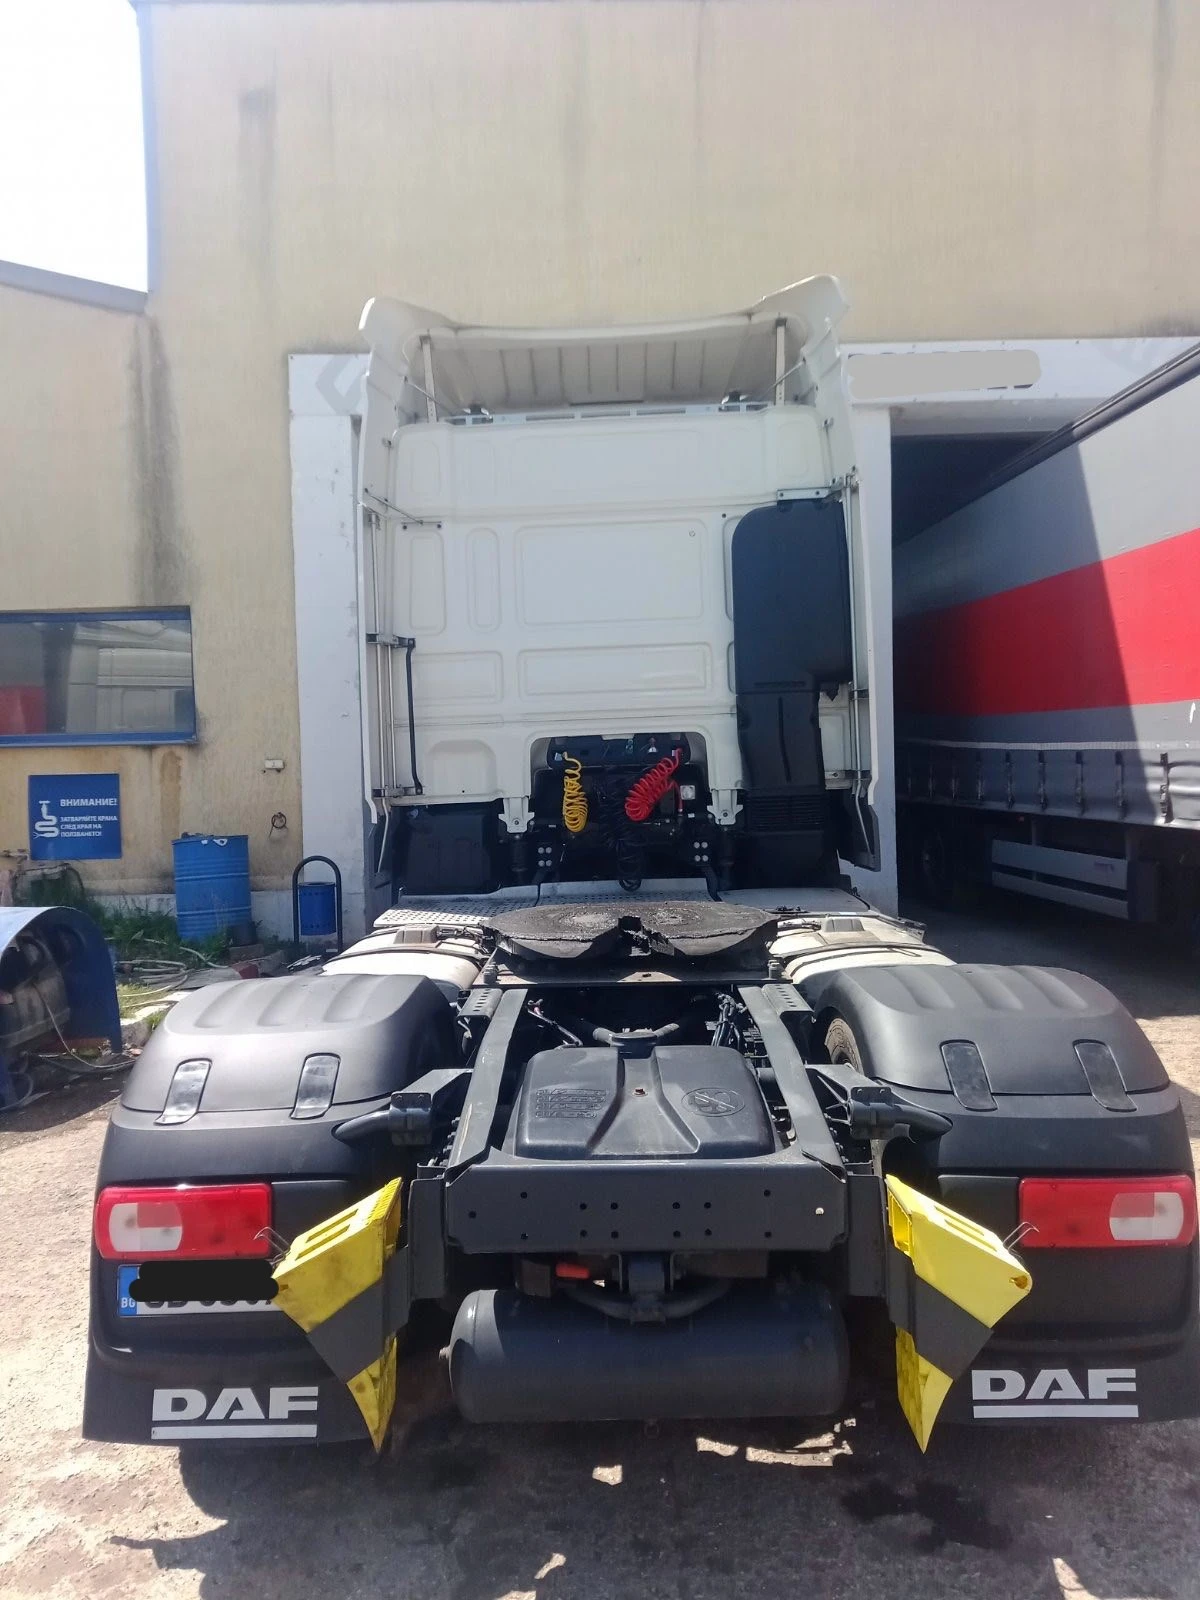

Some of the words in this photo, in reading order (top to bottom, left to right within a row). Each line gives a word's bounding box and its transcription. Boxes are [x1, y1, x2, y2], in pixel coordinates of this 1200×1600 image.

[60, 798, 118, 807] ВНИМАНИЕ!
[121, 1297, 136, 1308] BG
[972, 1368, 1137, 1400] DAF
[152, 1386, 319, 1421] DAF
